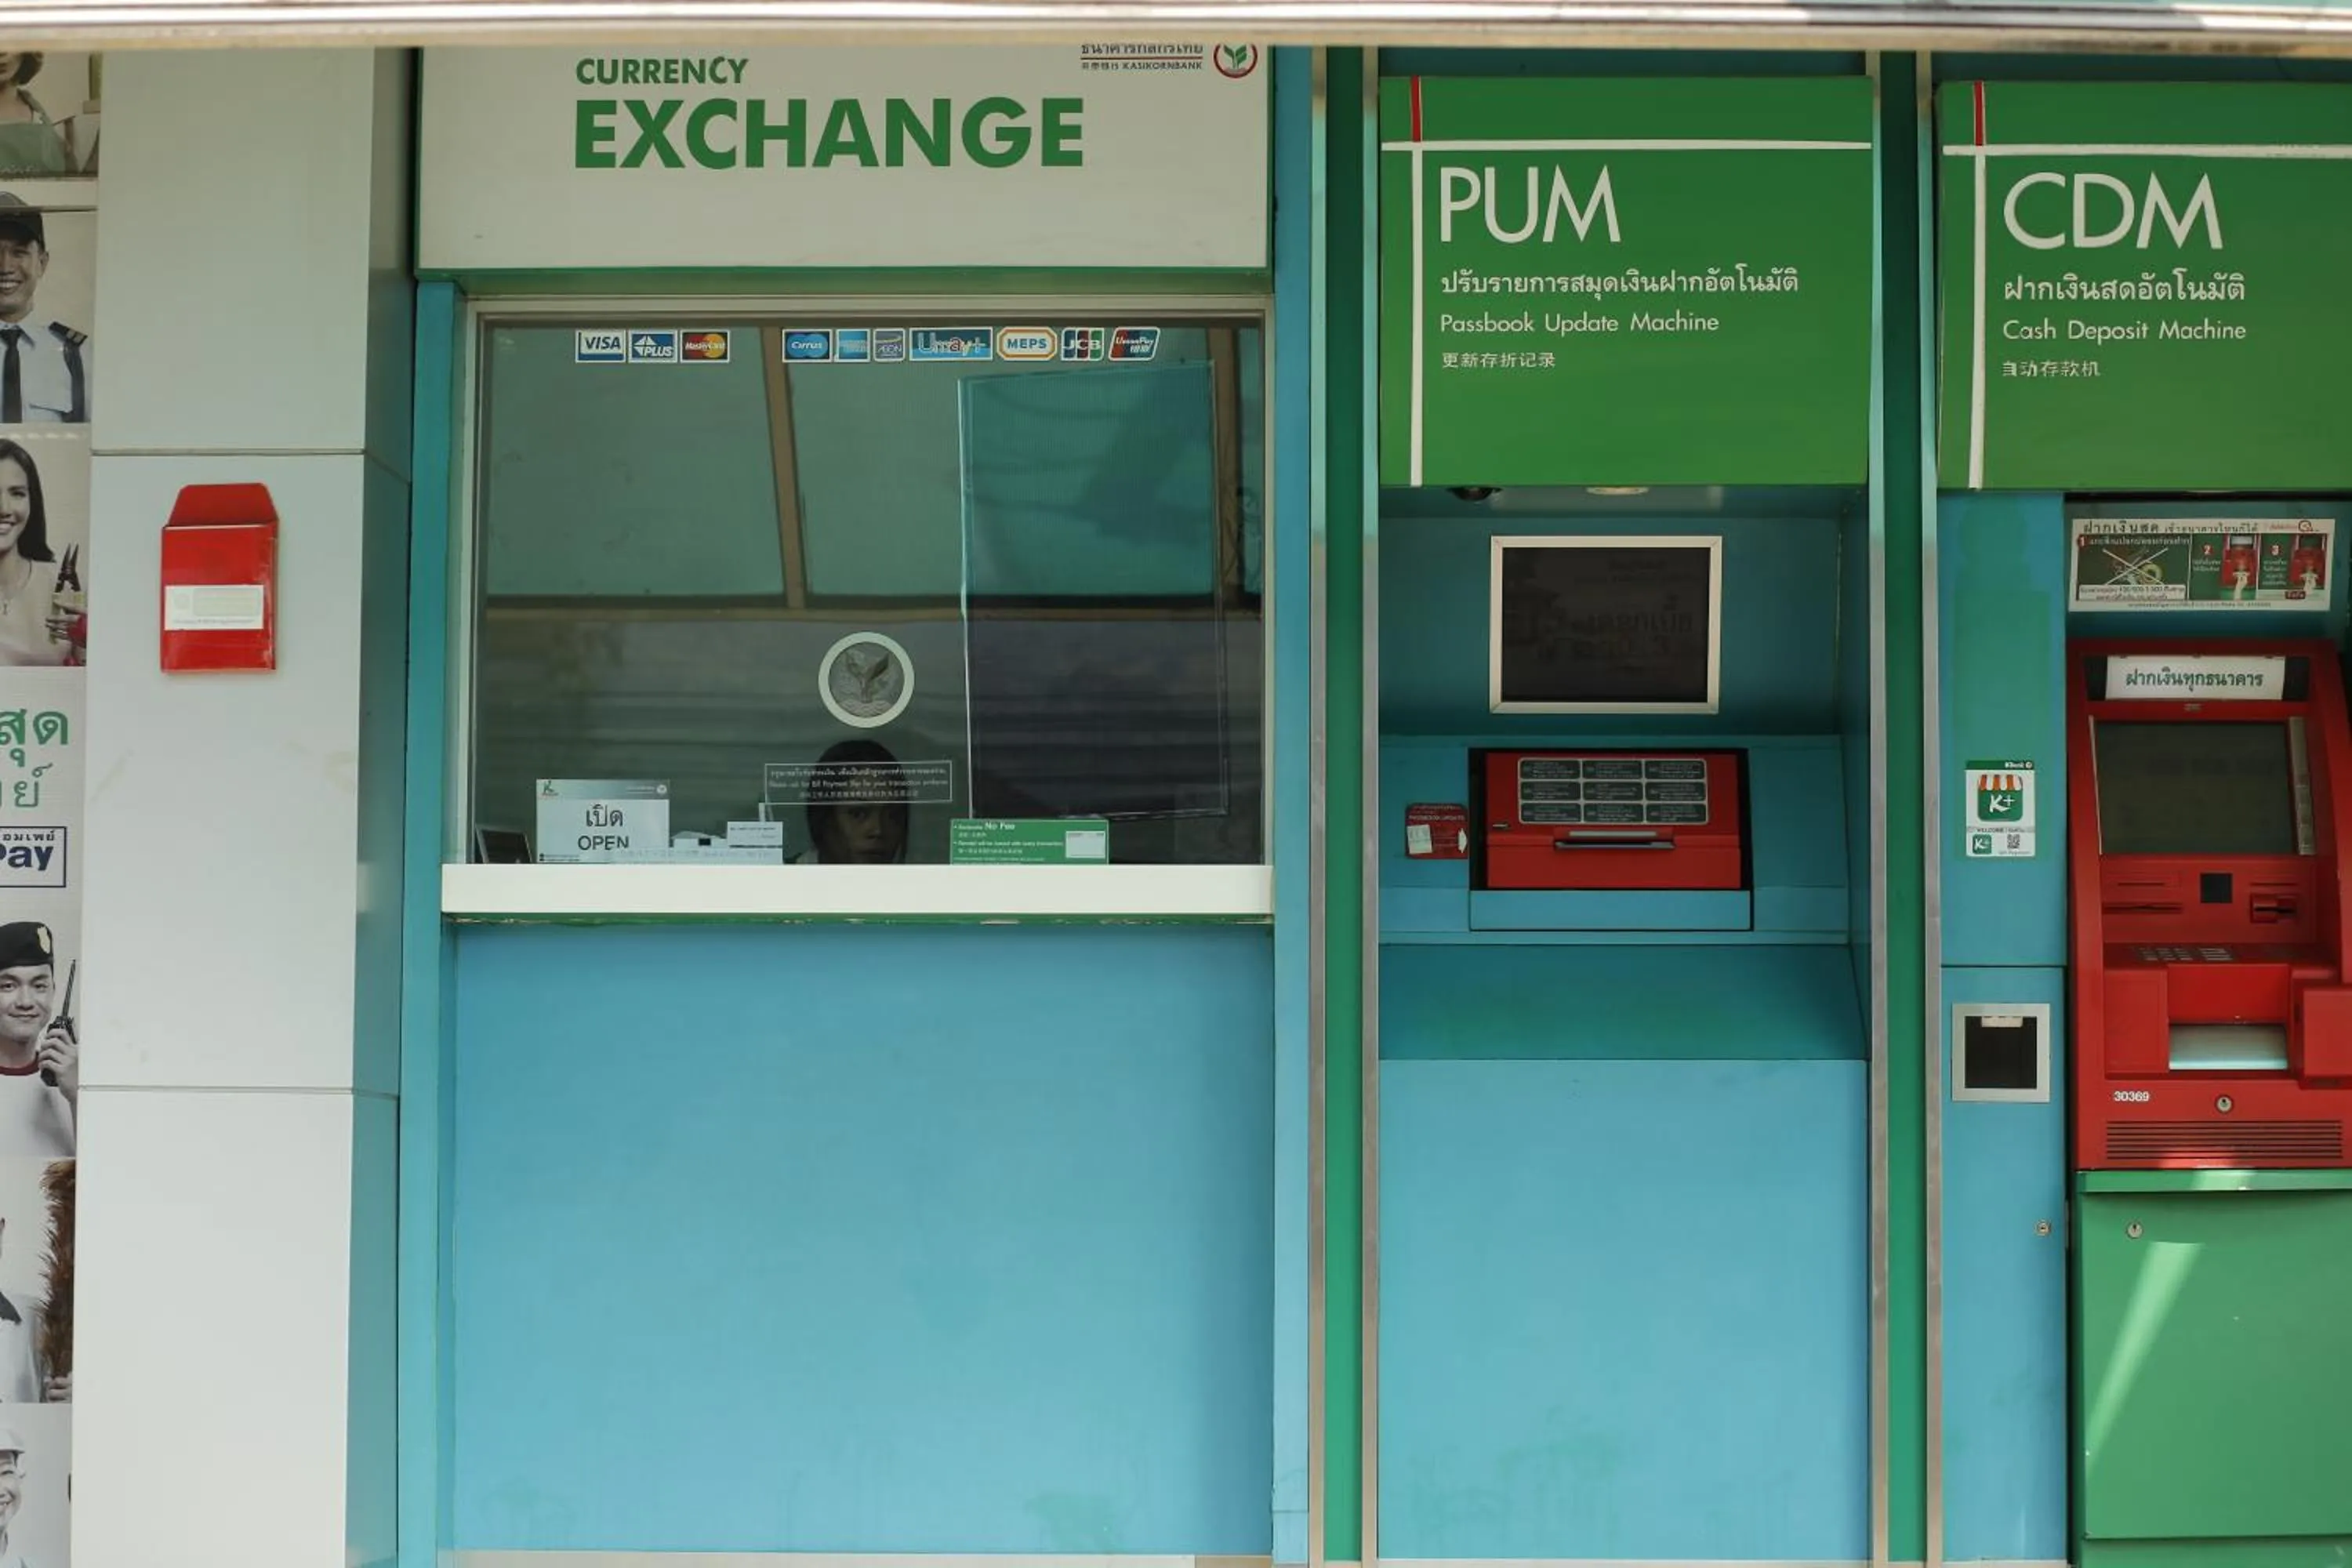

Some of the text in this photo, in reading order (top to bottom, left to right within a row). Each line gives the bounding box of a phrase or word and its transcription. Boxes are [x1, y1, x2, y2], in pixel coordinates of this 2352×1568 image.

[576, 56, 750, 85] CURRENCY
[1123, 62, 1203, 71] KASIKORNBANK
[575, 96, 1083, 169] EXCHANGE
[1440, 164, 1621, 243] PUM
[2004, 172, 2223, 249] CDM
[1441, 263, 1798, 300] ปรับรายการสมุดเงินฝากอัตโนมัติ
[2004, 267, 2245, 300] ฝากเงินสดอัตโนมัติ
[1441, 309, 1720, 337] Passbook Update Machine
[2003, 318, 2246, 345] Cash Deposit Machine
[586, 336, 622, 350] VISA
[644, 346, 673, 357] PLUS
[791, 341, 822, 350] Cirrus
[1007, 338, 1047, 349] MEPS
[1062, 339, 1102, 350] JCB
[1441, 351, 1556, 368] 更新存折记录
[2002, 360, 2101, 377] 自动存款机
[2125, 666, 2263, 692] ฝากเงินทุกธนาคาร
[1990, 794, 2016, 813] K+
[586, 804, 623, 826] เปิด
[577, 836, 629, 851] OPEN
[2114, 1091, 2151, 1102] 30369
